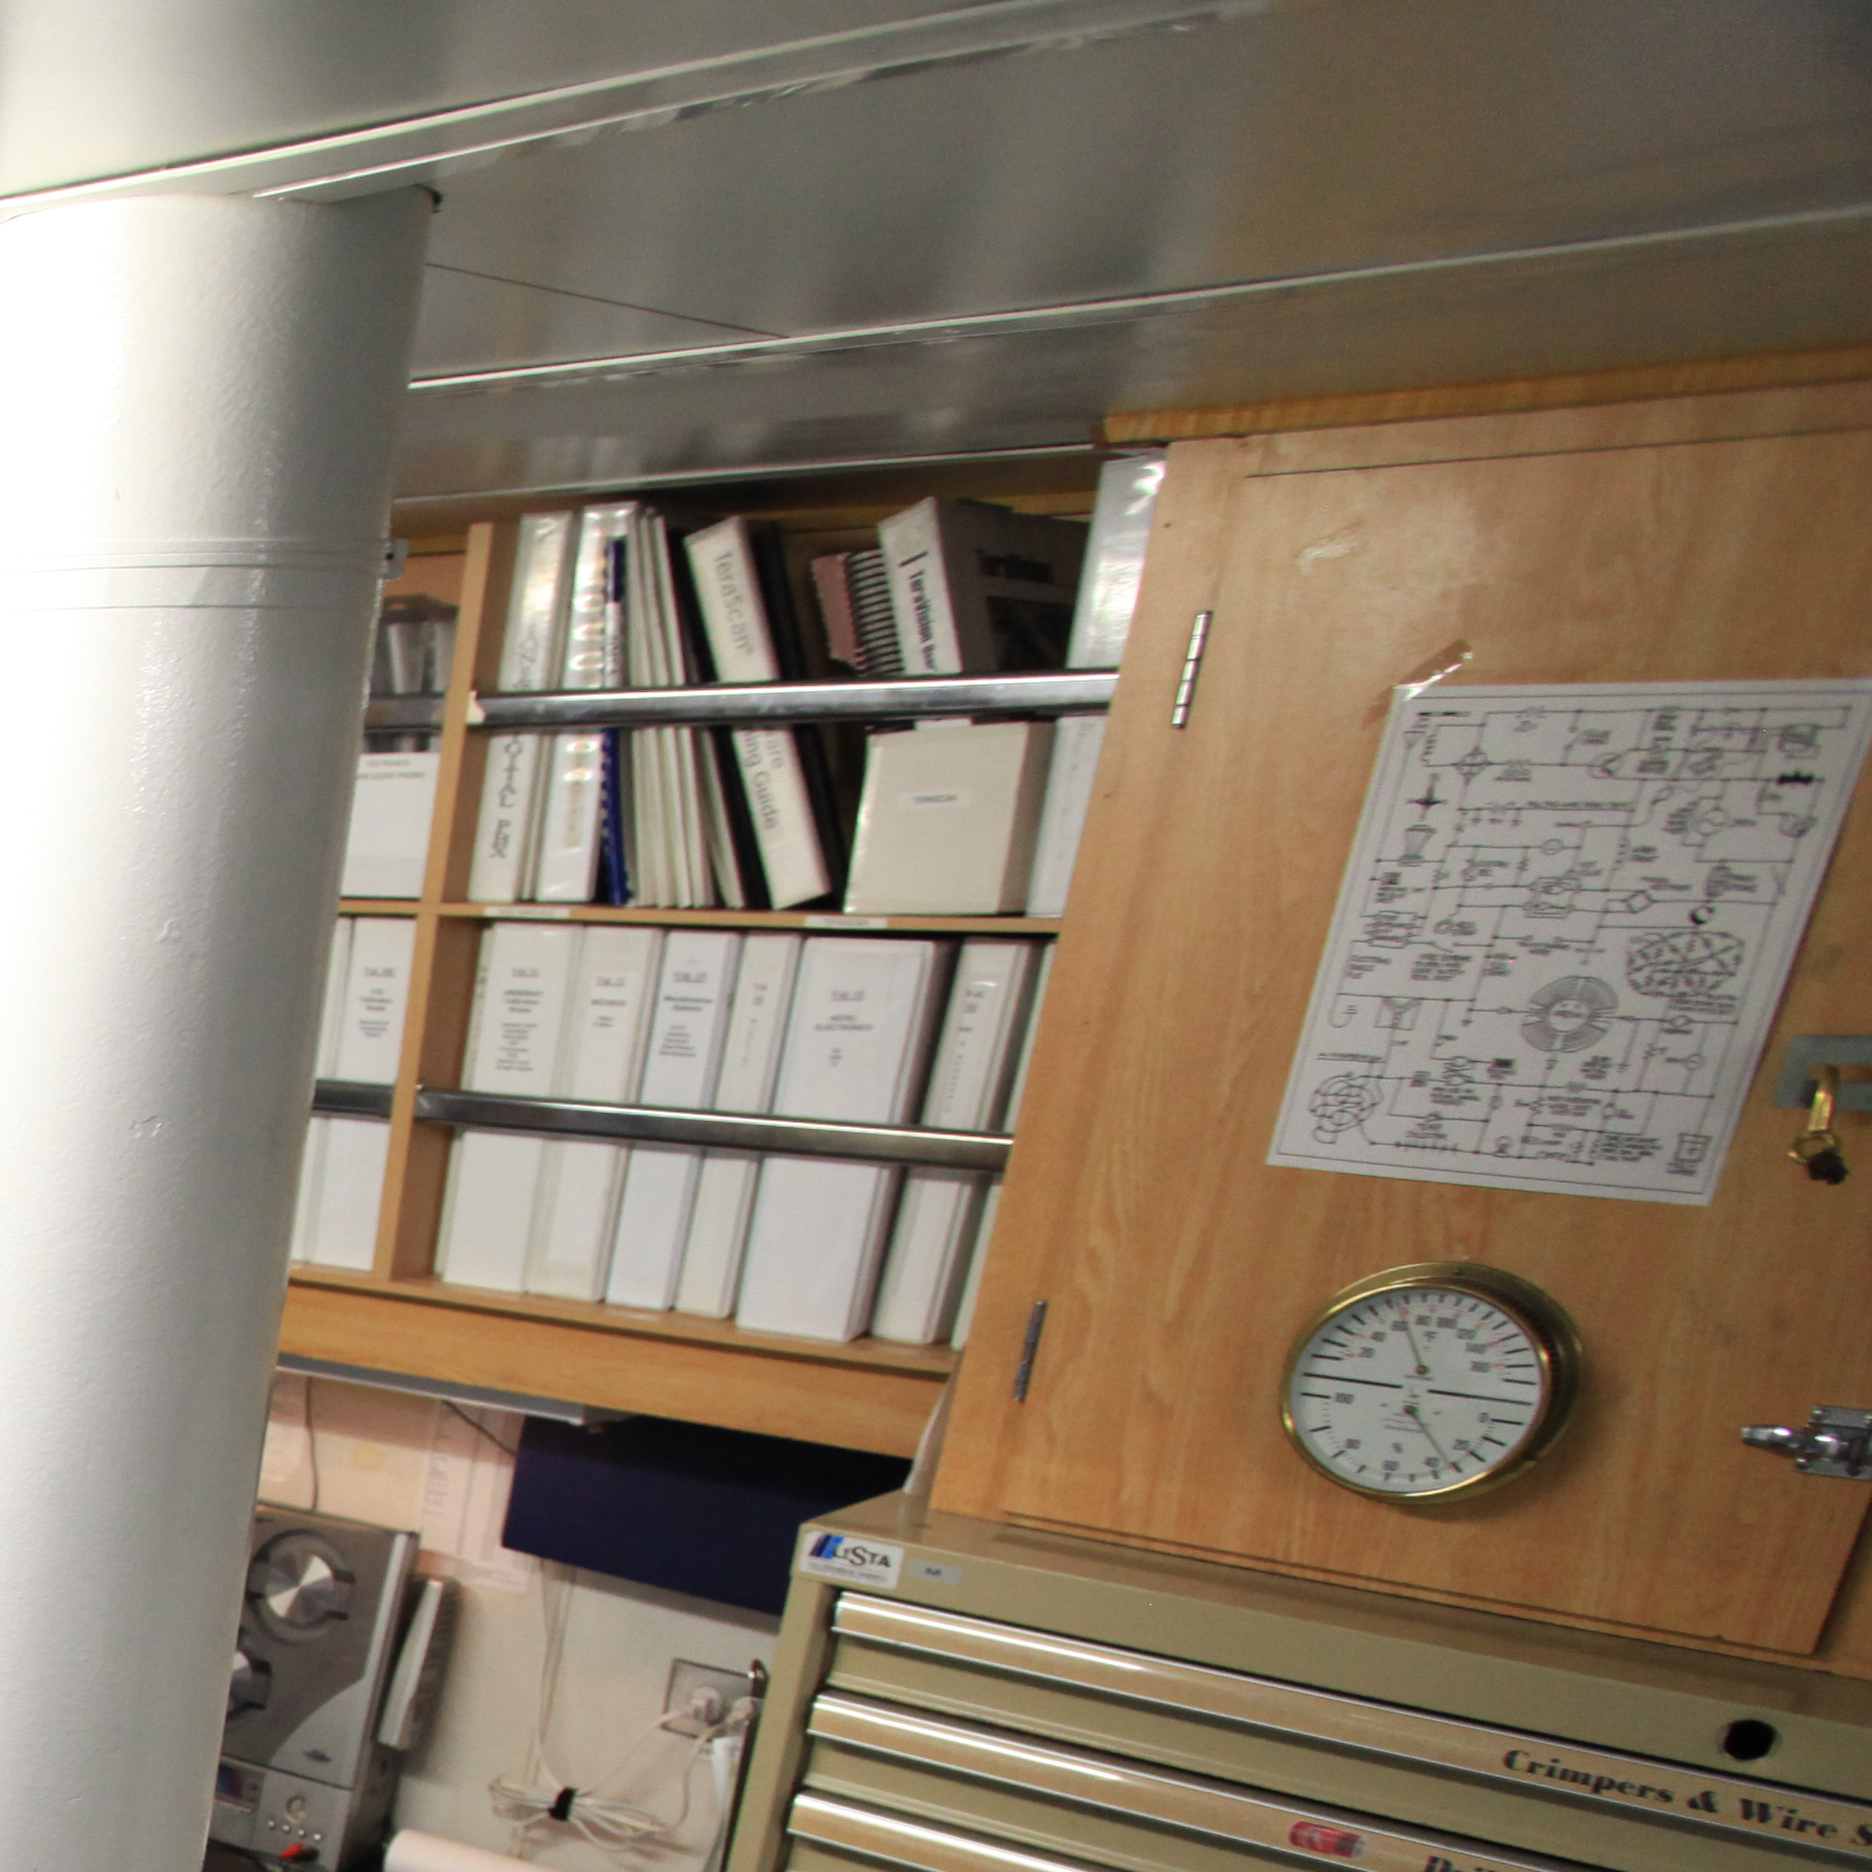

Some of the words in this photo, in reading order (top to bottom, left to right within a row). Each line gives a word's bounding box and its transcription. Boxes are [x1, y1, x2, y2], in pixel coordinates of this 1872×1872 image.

[836, 1537, 892, 1568] LISTA
[1503, 1750, 1675, 1804] Crimpers
[1687, 1790, 1720, 1813] &
[1740, 1798, 1839, 1838] Wire
